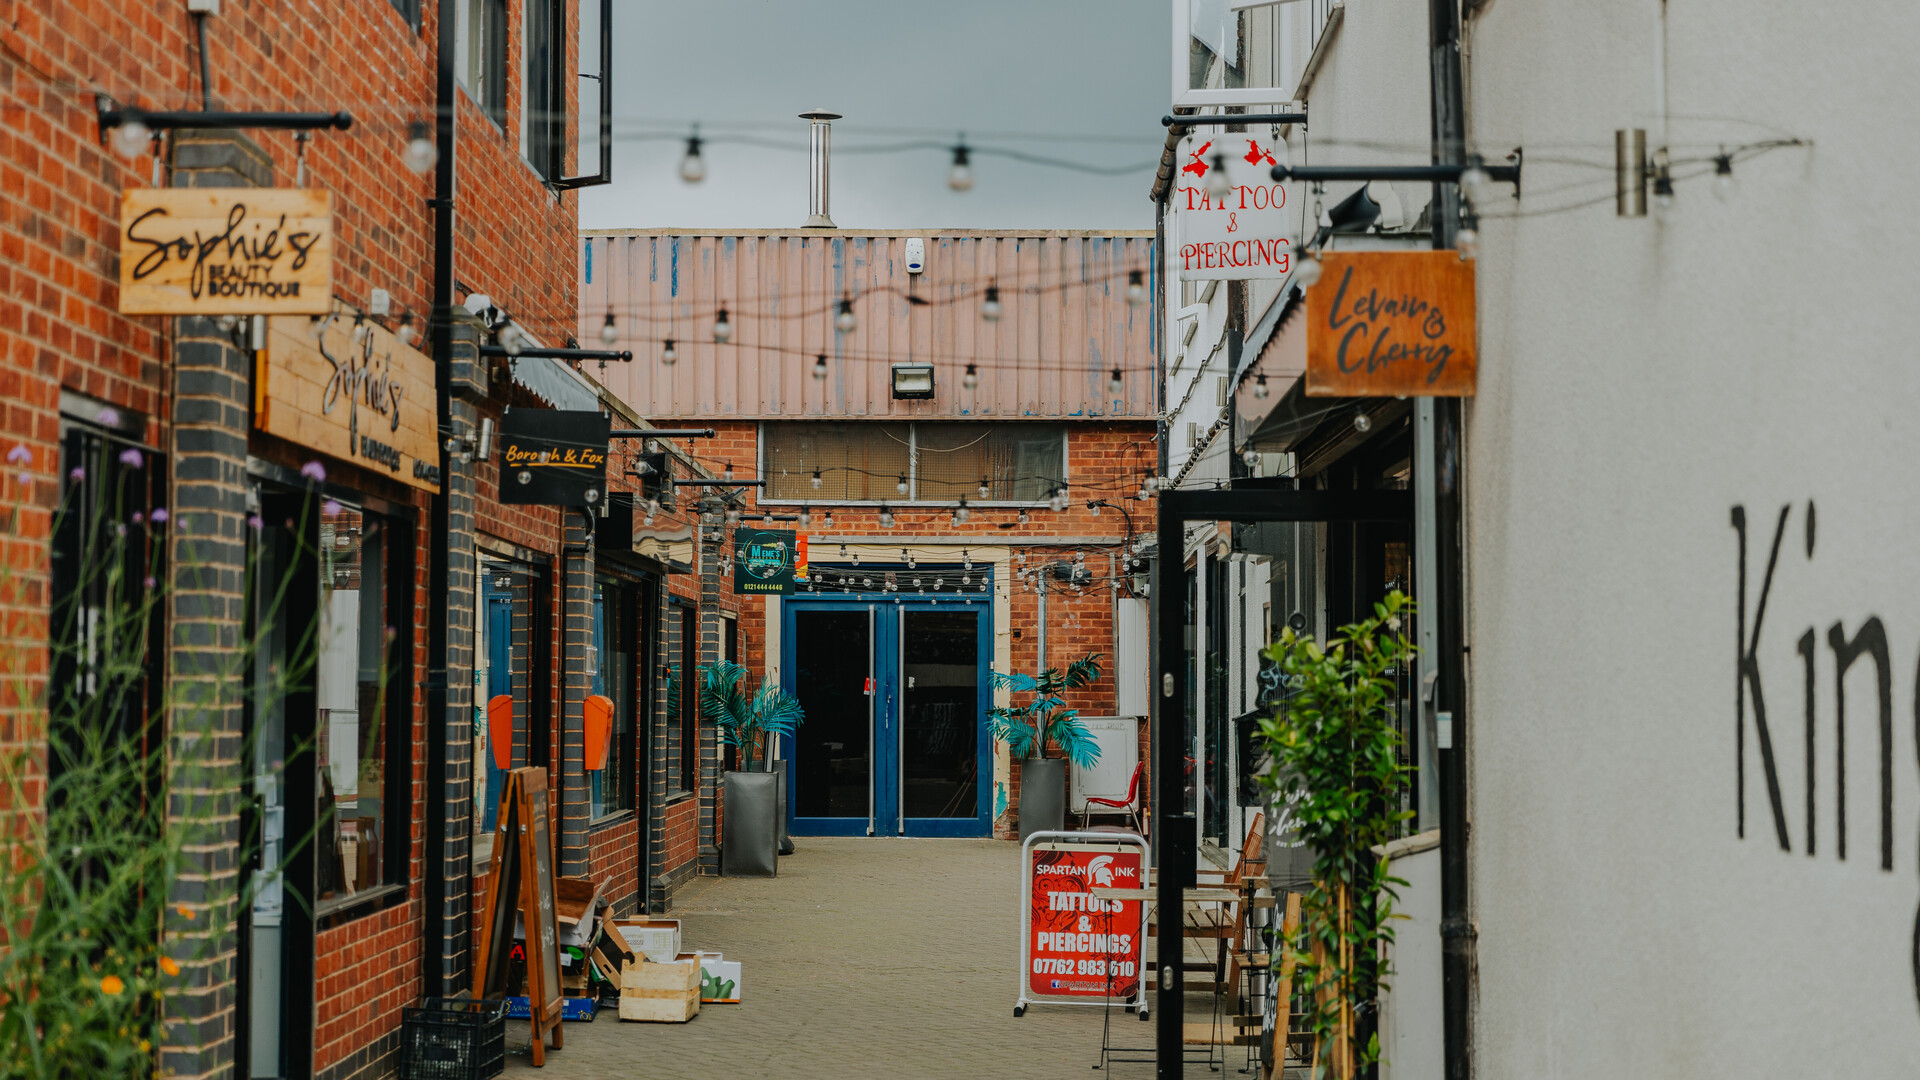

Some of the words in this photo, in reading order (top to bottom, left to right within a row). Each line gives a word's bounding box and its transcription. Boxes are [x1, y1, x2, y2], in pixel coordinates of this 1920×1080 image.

[1178, 184, 1286, 211] TATTOO
[1226, 212, 1238, 233] &
[128, 203, 320, 299] Sophie's
[1180, 238, 1289, 274] PIERCING
[209, 264, 273, 280] BEAUTY
[209, 281, 300, 299] BOUTIQUE
[1329, 265, 1428, 330] Levain
[1422, 307, 1446, 340] &
[1337, 321, 1455, 385] Cherry
[564, 449, 577, 464] &
[580, 449, 604, 464] Fox
[1730, 498, 1920, 1025] Kin
[1036, 864, 1086, 876] SPARTAN
[1115, 867, 1135, 877] INK
[1078, 915, 1092, 932] &
[1037, 931, 1132, 954] PIERCINGS
[1033, 958, 1075, 975] 07762
[1077, 959, 1106, 976] 983
[1109, 961, 1135, 977] 610
[1060, 980, 1098, 989] SPARTAN
